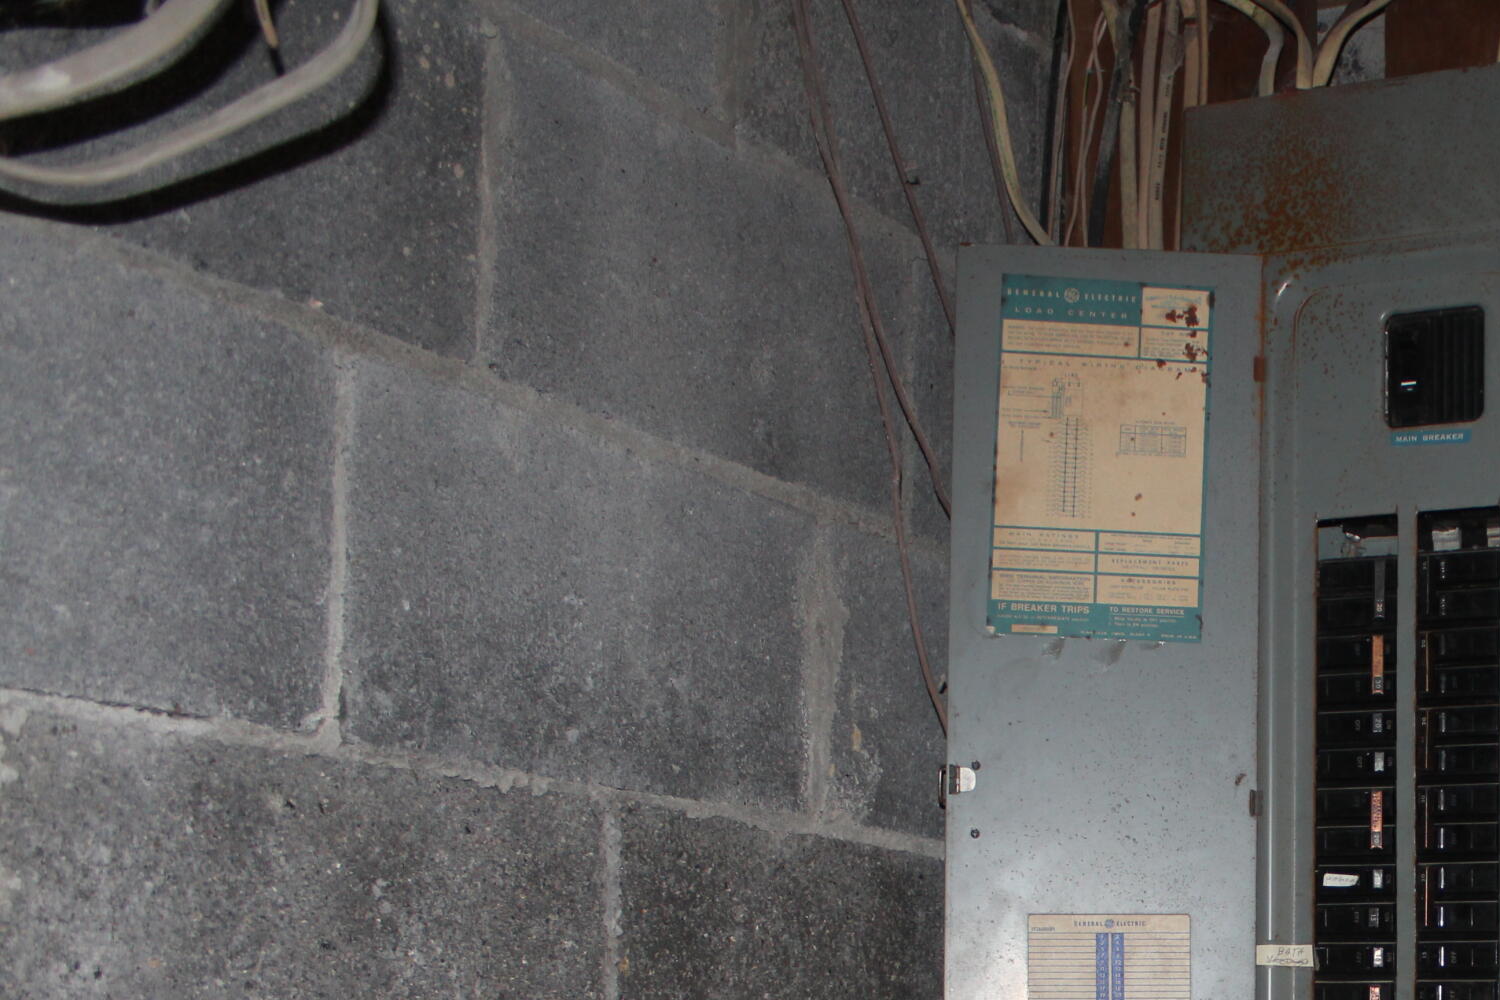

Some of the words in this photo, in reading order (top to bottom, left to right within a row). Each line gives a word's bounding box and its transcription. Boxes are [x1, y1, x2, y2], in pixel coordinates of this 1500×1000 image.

[1014, 306, 1055, 316] LOAD
[1423, 432, 1464, 442] BREAKER
[998, 602, 1007, 610] IF
[1011, 602, 1057, 612] BREAKER
[1062, 605, 1090, 615] TRIPS
